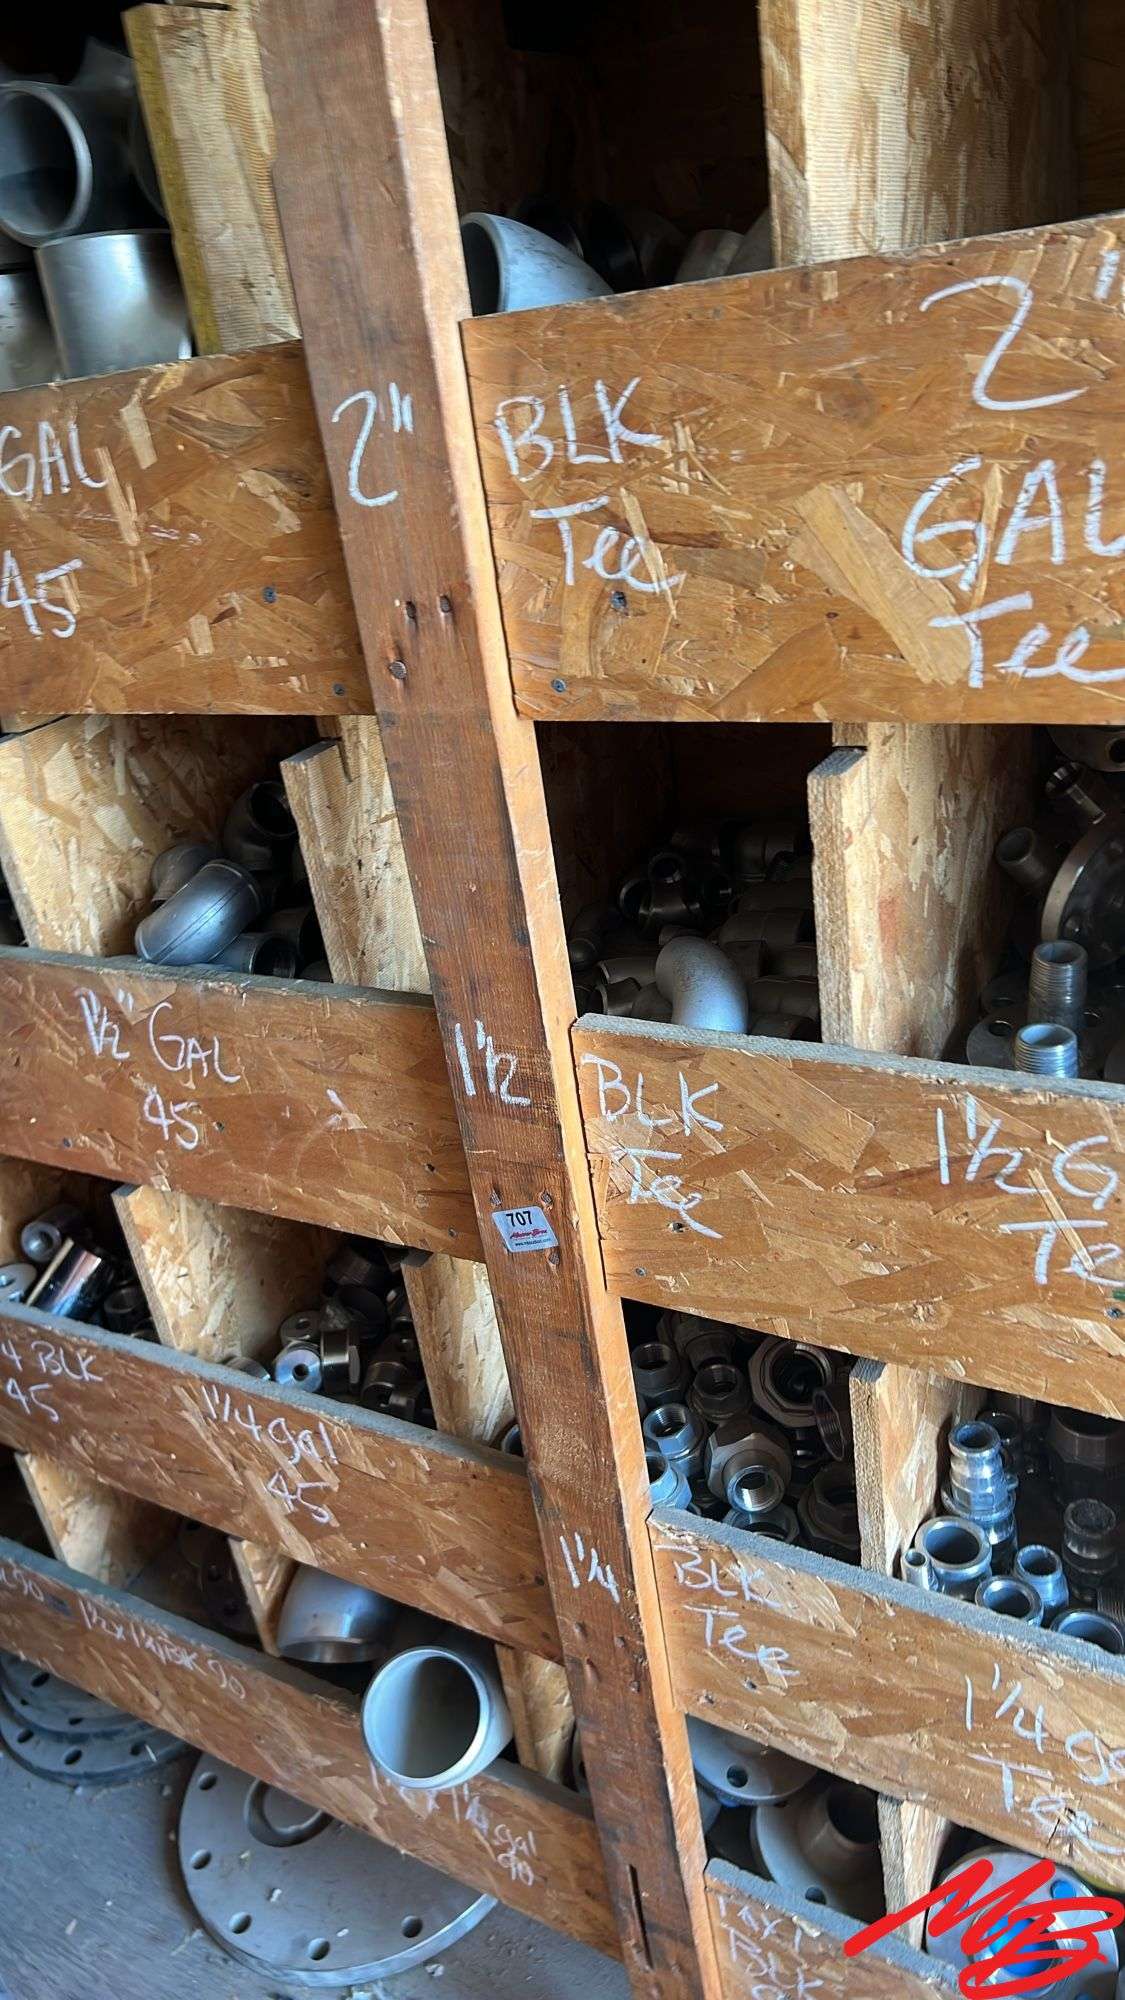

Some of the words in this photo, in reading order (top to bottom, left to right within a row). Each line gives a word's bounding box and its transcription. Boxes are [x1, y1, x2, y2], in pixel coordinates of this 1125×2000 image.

[0, 422, 108, 502] GAL
[495, 377, 663, 483] BLK
[529, 495, 686, 592] Tee
[0, 548, 84, 641] 45
[927, 590, 1125, 690] Tee
[149, 1001, 241, 1084] GAL
[142, 1086, 200, 1150] 45
[580, 1052, 724, 1137] BLK
[506, 1210, 533, 1227] 707
[606, 1146, 724, 1240] Tee
[31, 1340, 104, 1382] BLK
[6, 1377, 60, 1424] 45
[267, 1417, 341, 1466] gal
[266, 1470, 334, 1525] 45
[654, 1543, 785, 1610] BLK
[682, 1602, 800, 1679] Tee
